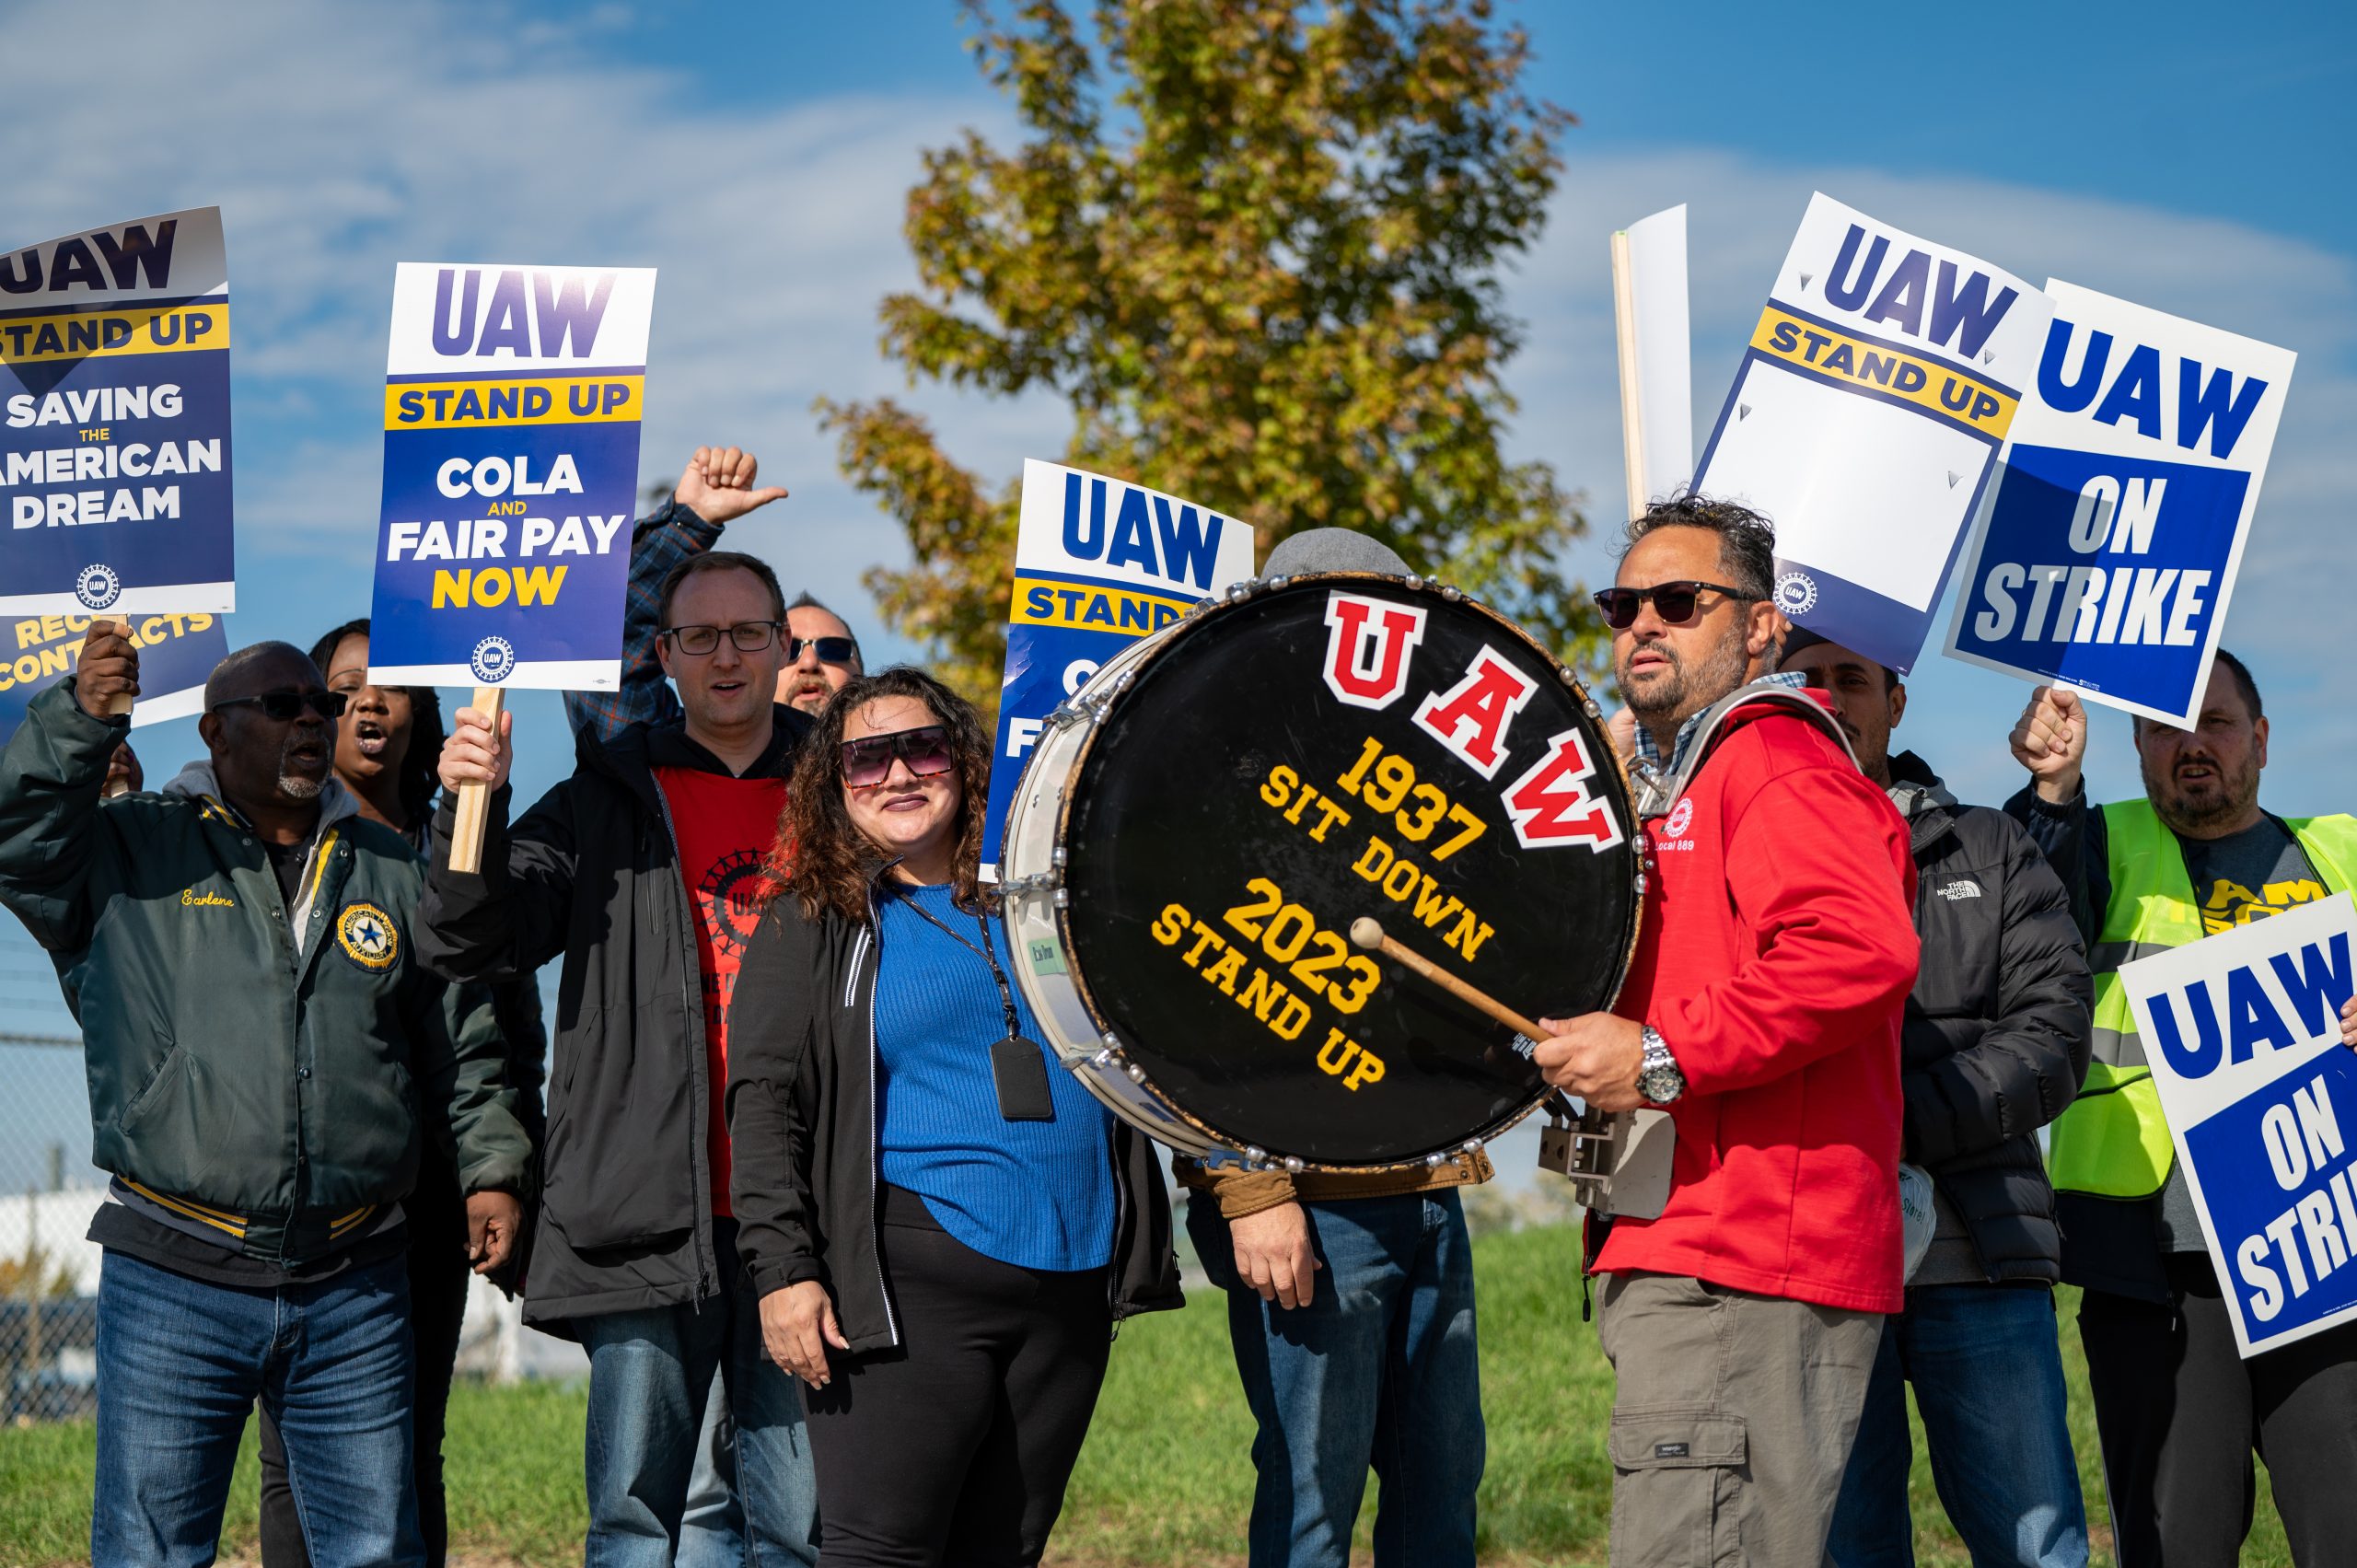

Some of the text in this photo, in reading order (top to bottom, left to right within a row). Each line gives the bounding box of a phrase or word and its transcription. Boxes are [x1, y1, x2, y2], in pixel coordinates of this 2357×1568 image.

[0, 220, 177, 294] UAW
[432, 269, 618, 358] UAW
[1824, 223, 2020, 360] UAW
[0, 312, 214, 357] TAND UP
[1768, 321, 2001, 422] STAND UP
[2037, 317, 2270, 460] UAW
[6, 383, 183, 428] SAVING
[397, 383, 631, 423] STAND UP
[79, 427, 110, 442] THE
[0, 438, 222, 486] MERICAN
[436, 453, 585, 499] COLA
[12, 485, 180, 529] DREAM
[487, 501, 528, 517] AND
[2068, 474, 2167, 554] ON
[387, 514, 627, 562] FAIR PAY
[1062, 472, 1225, 592] UAW
[88, 580, 107, 591] UAW
[431, 565, 569, 610] NOW
[1784, 586, 1805, 600] UAW
[1974, 562, 2212, 646] STRIKE
[1024, 587, 1181, 633] STAND
[483, 653, 502, 664] UAW
[1322, 589, 1625, 854] UAW
[1336, 737, 1488, 862] 1937
[1260, 765, 1495, 963] SIT DOWN
[1677, 839, 1695, 852] 889
[732, 890, 769, 917] UA
[1936, 885, 1967, 896] NORTH
[1946, 880, 1965, 889] THE
[1946, 891, 1968, 901] FACE
[1223, 877, 1381, 1015] 2023
[1151, 903, 1386, 1092] STAND UP
[2145, 931, 2354, 1080] UAW
[2261, 1073, 2346, 1192] ON
[2236, 1158, 2357, 1323] STRI
